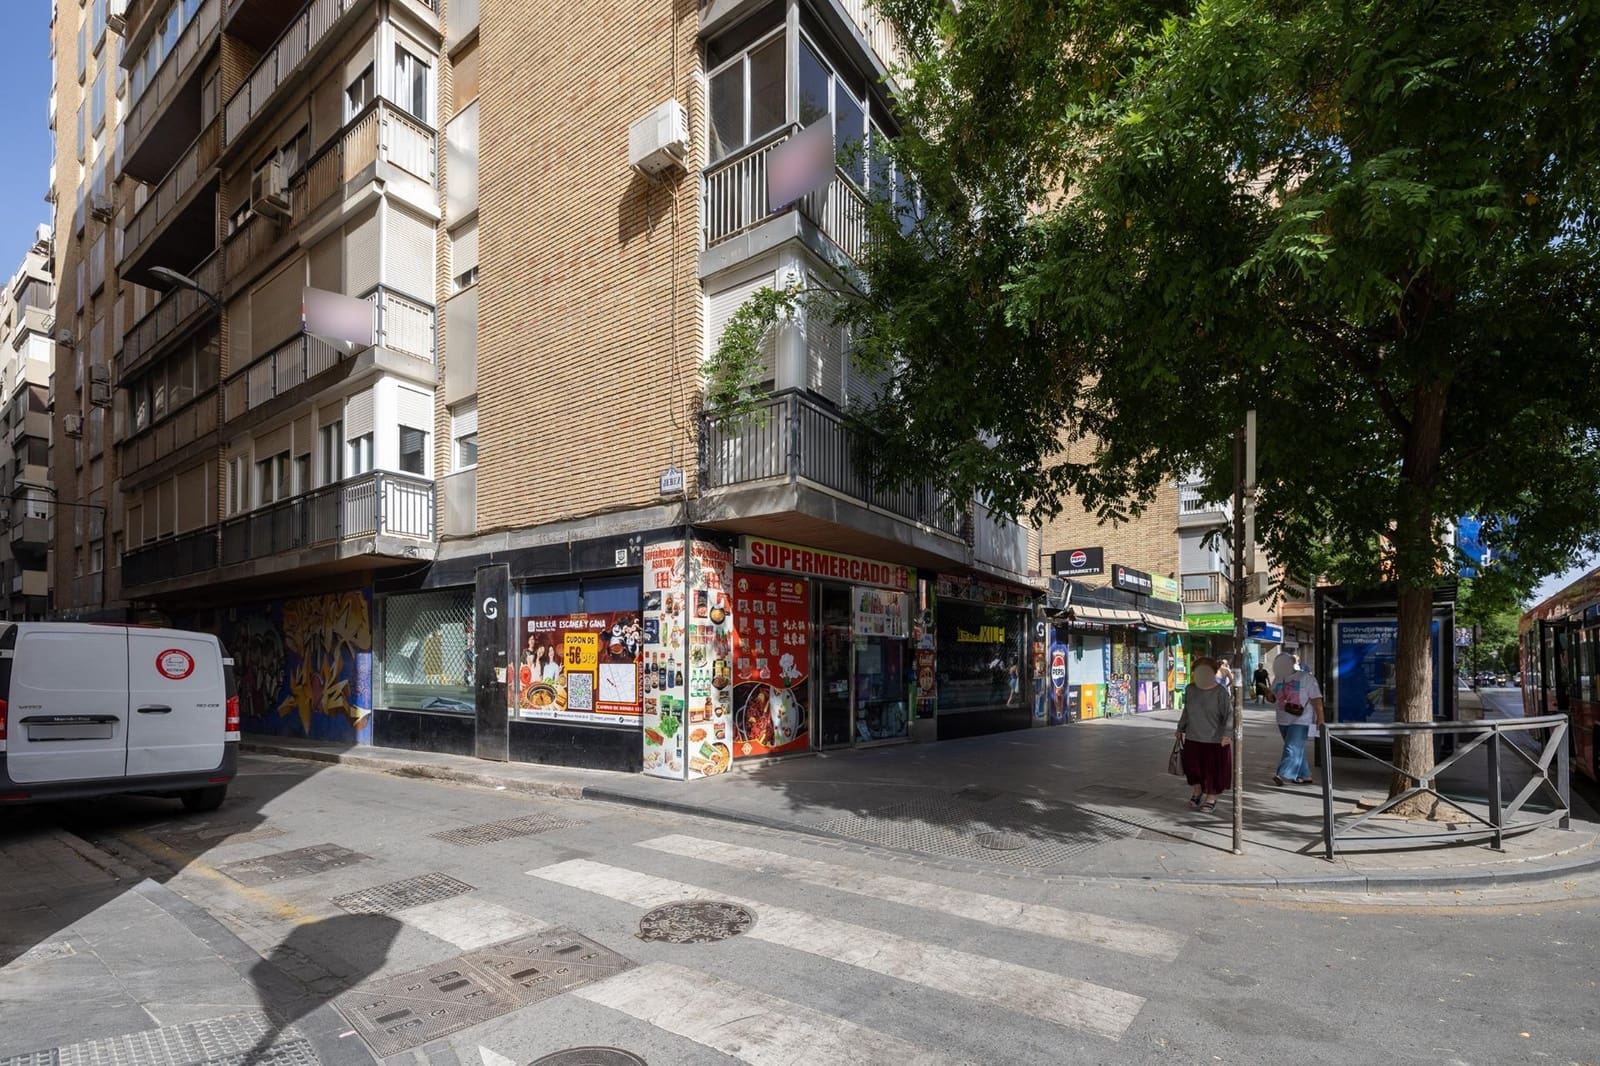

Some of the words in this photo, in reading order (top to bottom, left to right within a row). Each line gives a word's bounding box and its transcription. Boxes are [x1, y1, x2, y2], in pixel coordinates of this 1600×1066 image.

[751, 541, 890, 585] SUPERMERCADO
[483, 597, 498, 619] G
[590, 619, 606, 628] GANA
[1036, 622, 1045, 637] G
[566, 636, 586, 644] CUPON
[587, 637, 595, 645] DE
[1052, 668, 1065, 676] PEPSI
